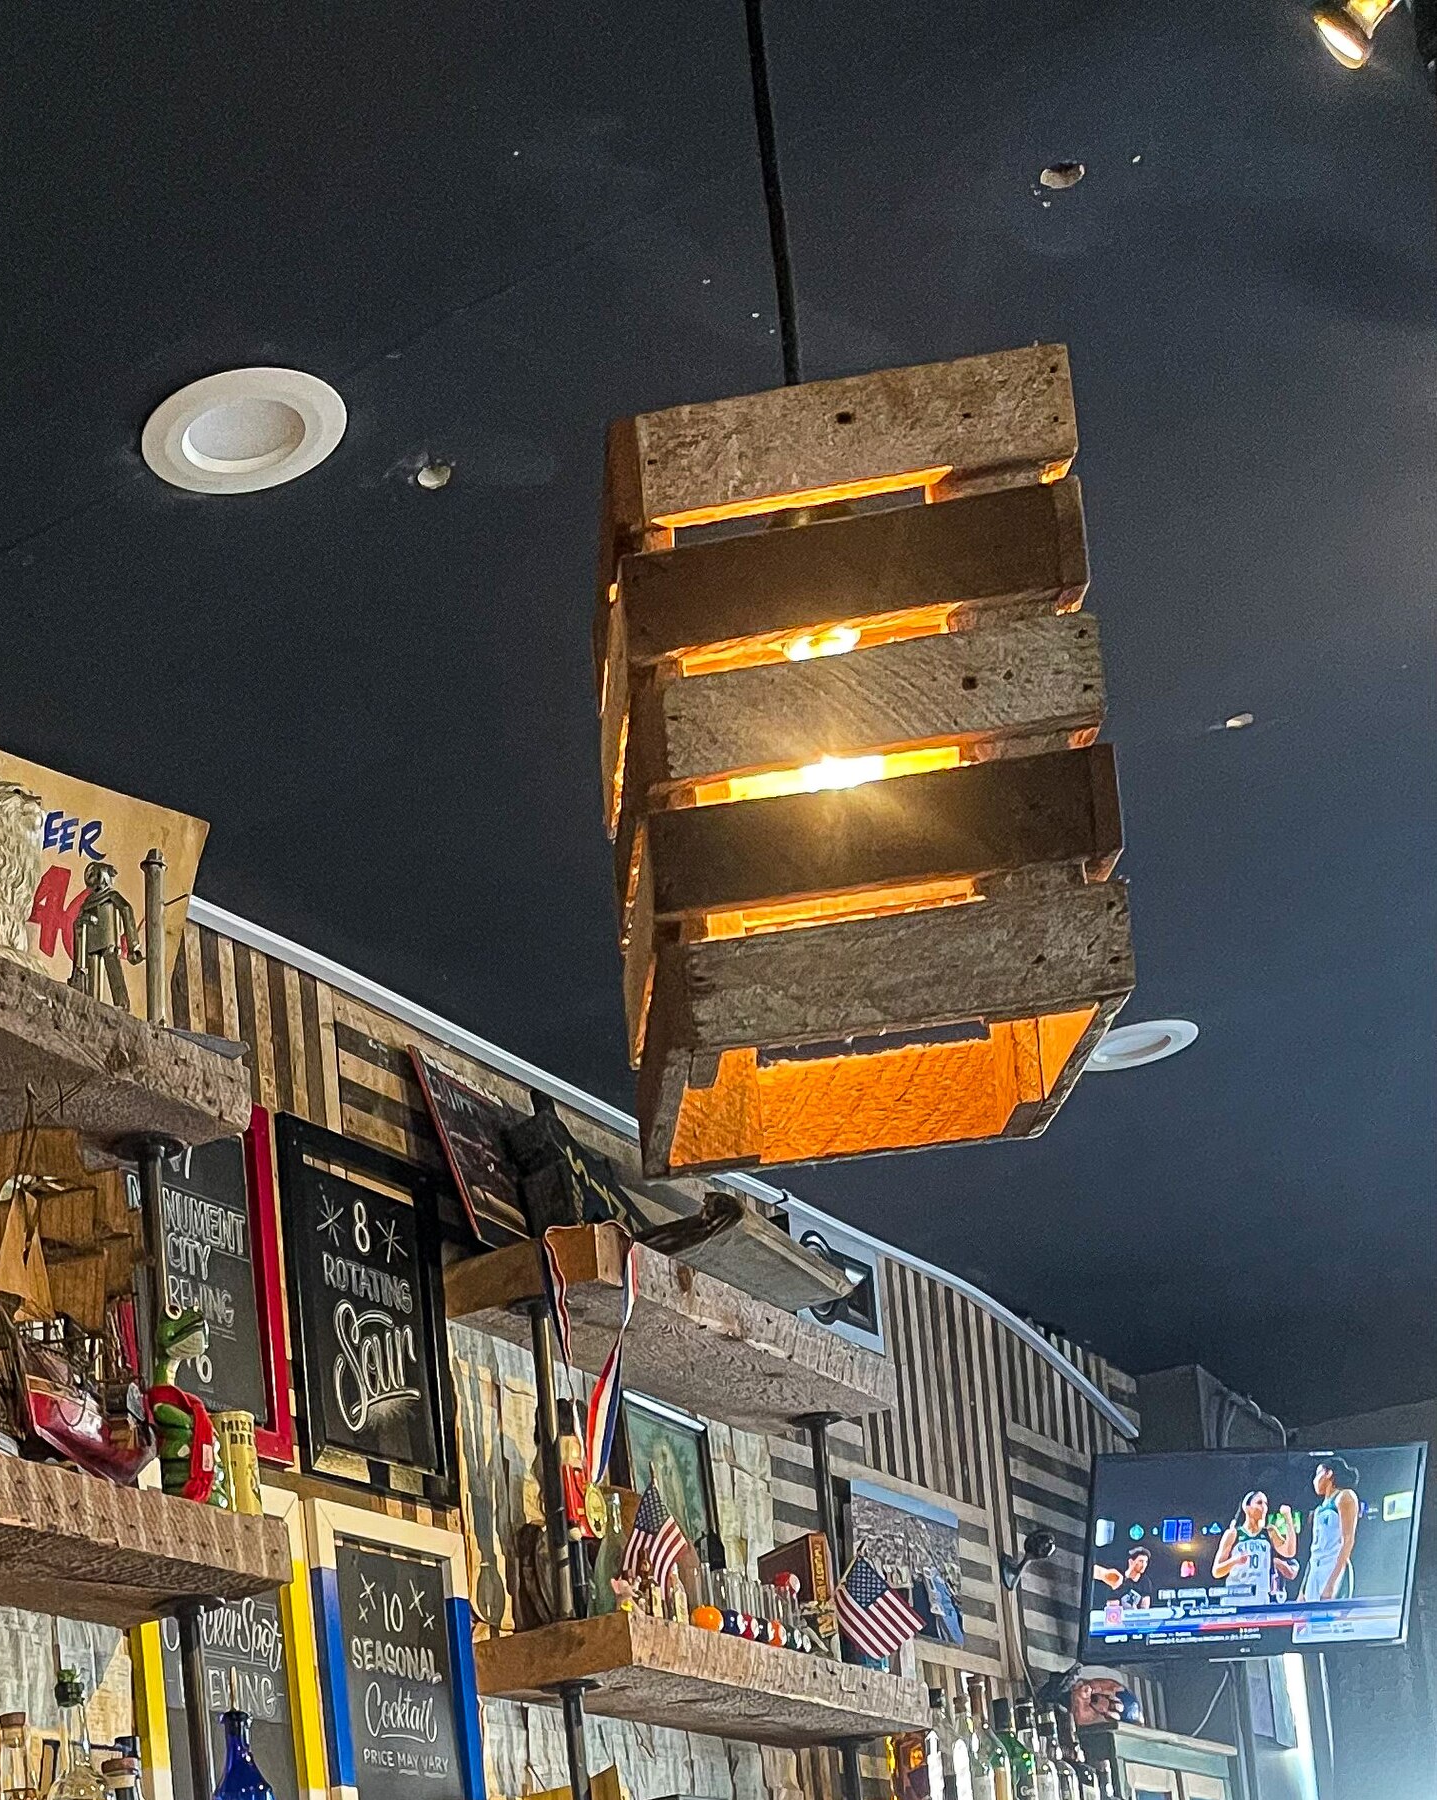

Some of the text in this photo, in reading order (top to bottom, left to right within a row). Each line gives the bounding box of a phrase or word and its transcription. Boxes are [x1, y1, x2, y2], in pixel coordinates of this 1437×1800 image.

[42, 810, 107, 861] EER
[352, 1200, 370, 1253] 8
[167, 1232, 211, 1281] CITY
[322, 1250, 413, 1314] ROTATING
[334, 1299, 420, 1432] Sour
[382, 1591, 403, 1633] 10
[351, 1635, 443, 1684] SEASONAL
[364, 1681, 437, 1743] Cocktail
[363, 1748, 449, 1774] PRICE MAY VARY
